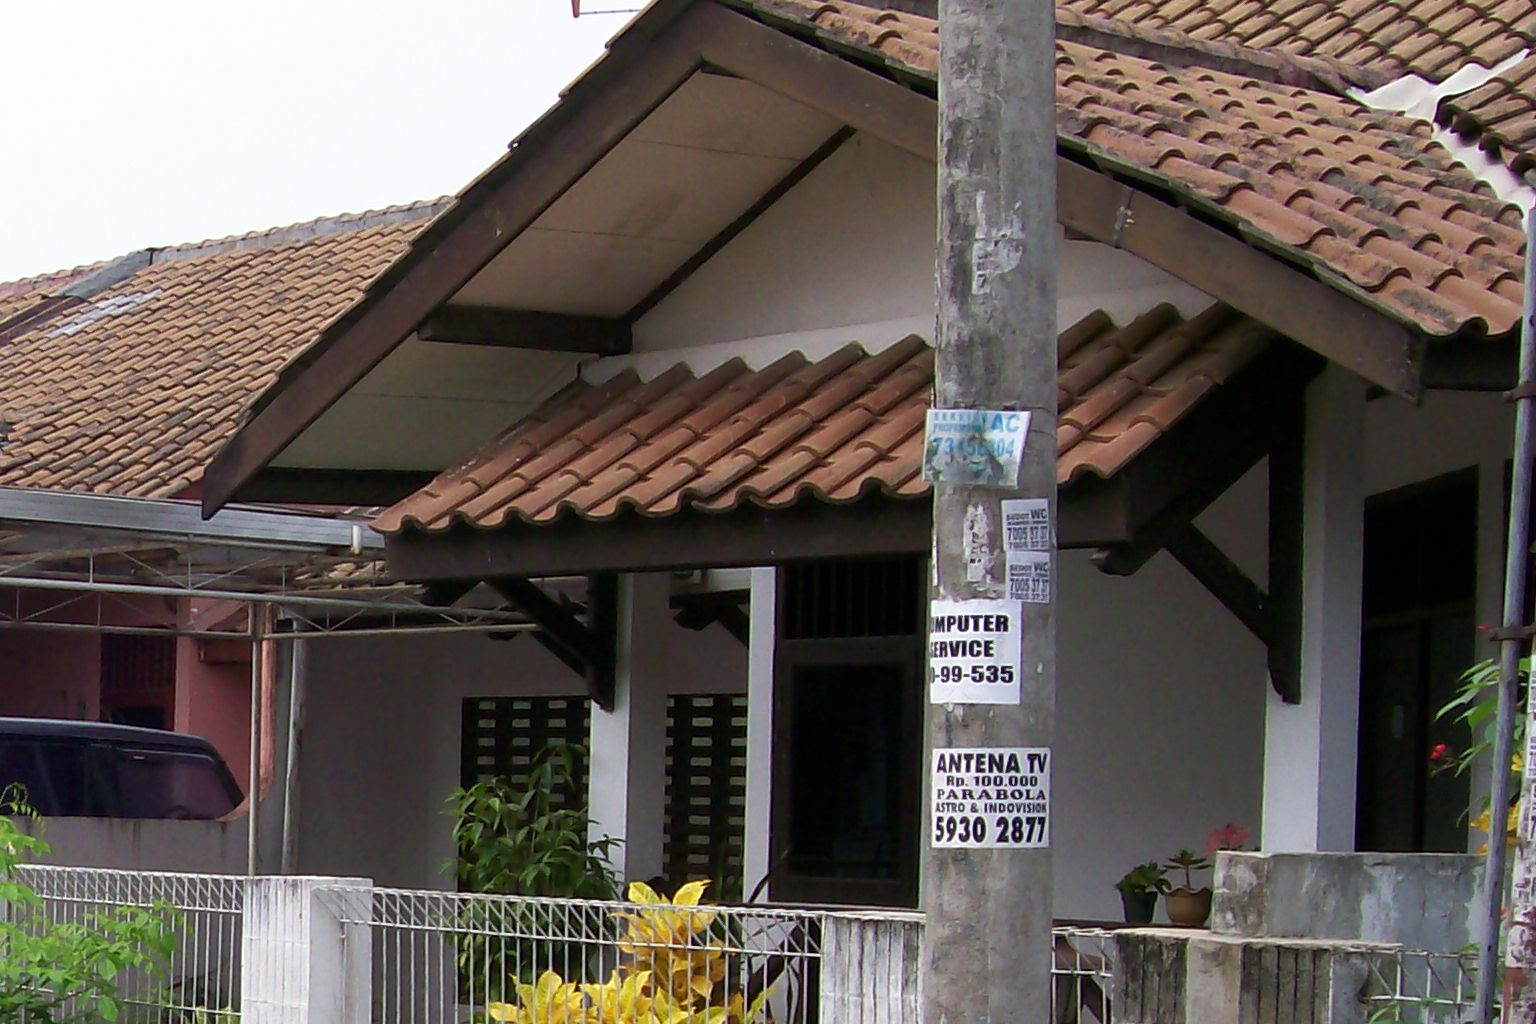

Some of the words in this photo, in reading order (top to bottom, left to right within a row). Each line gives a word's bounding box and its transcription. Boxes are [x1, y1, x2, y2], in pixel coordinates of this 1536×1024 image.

[990, 413, 1020, 433] AC
[1031, 508, 1047, 519] WC
[1034, 561, 1049, 572] WC
[936, 753, 1021, 773] ANTENA
[1027, 753, 1047, 773] TV
[946, 776, 968, 787] Rp.
[974, 775, 1038, 787] 100.000
[937, 789, 1046, 800] PARABOLA
[935, 802, 966, 813] ASTRO
[970, 802, 979, 813] &
[984, 802, 1047, 813] INDOVISION
[935, 816, 986, 843] 5930
[996, 816, 1047, 843] 2877
